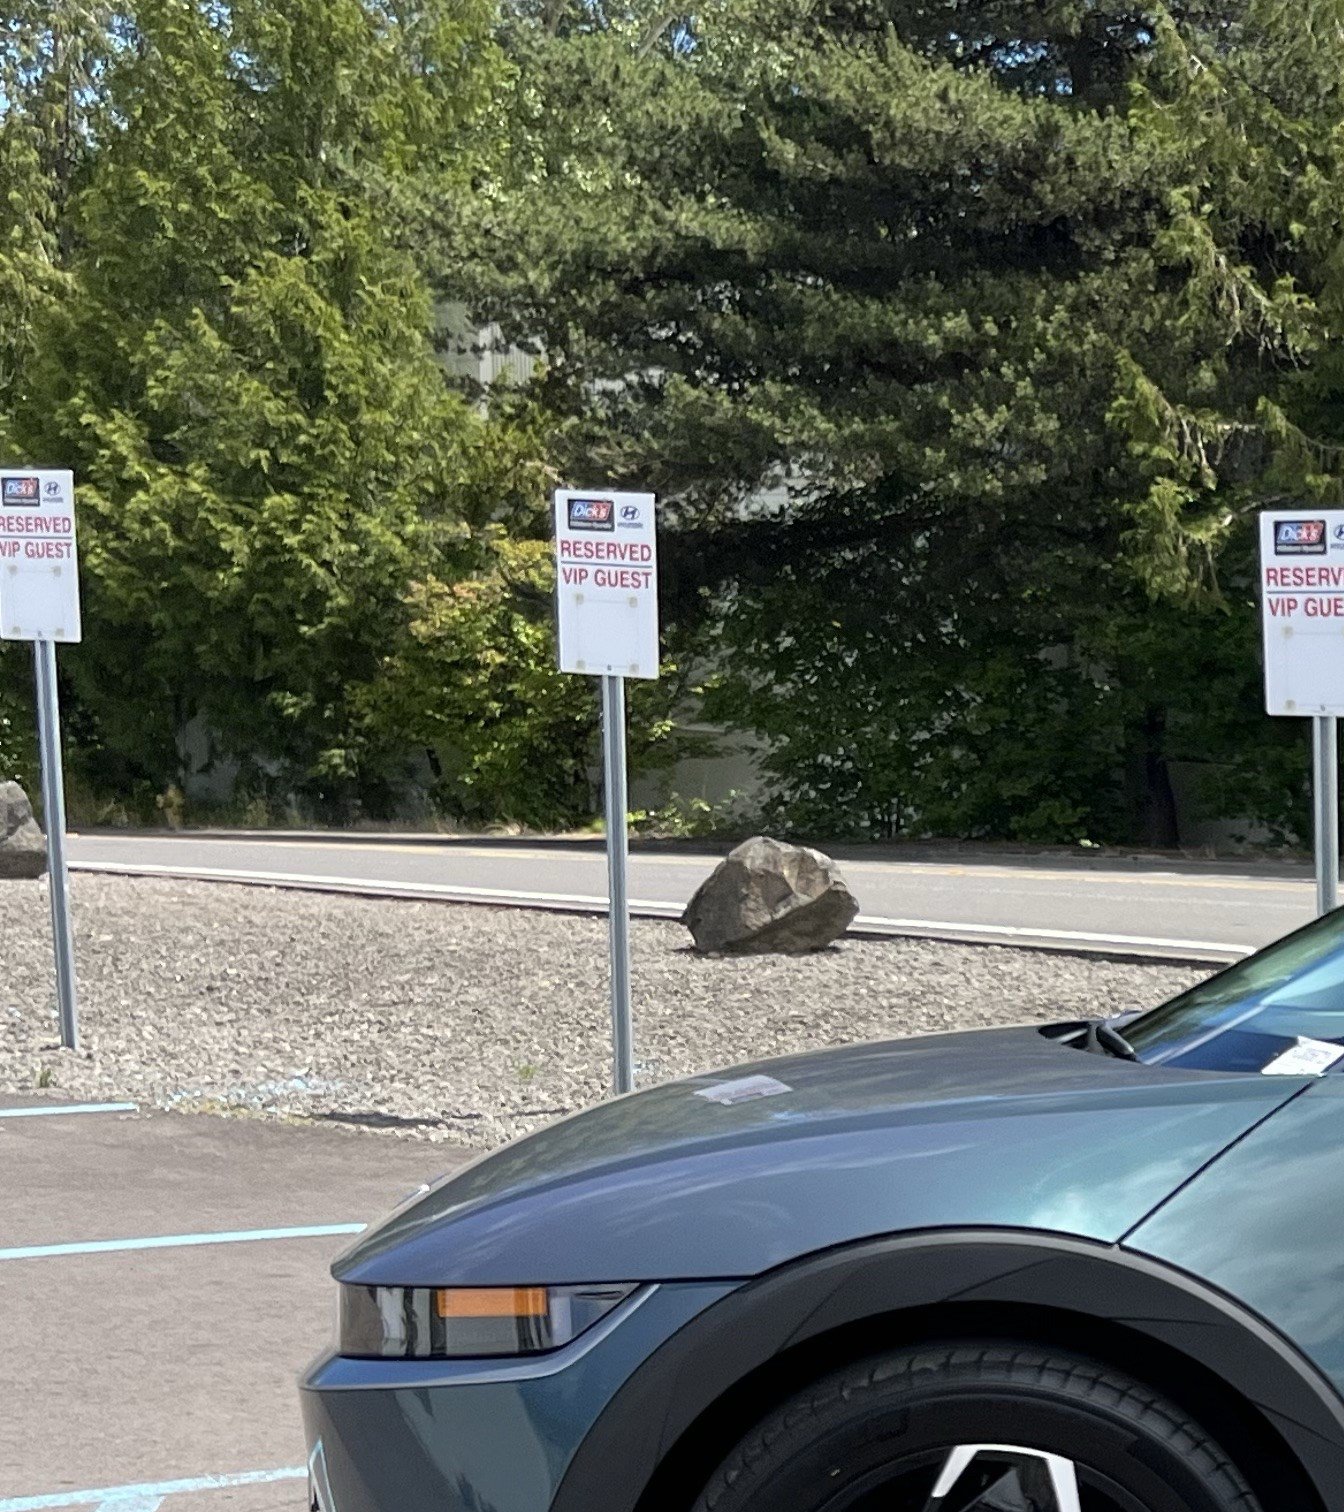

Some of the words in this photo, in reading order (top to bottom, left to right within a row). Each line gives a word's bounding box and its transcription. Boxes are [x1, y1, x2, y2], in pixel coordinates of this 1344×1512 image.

[0, 515, 72, 533] RESERVED
[0, 541, 21, 558] VIP
[24, 541, 72, 559] GUEST
[560, 540, 652, 562] RESERVED
[562, 567, 588, 586] VIP
[594, 569, 653, 589] GUEST
[1267, 597, 1298, 617] VIP
